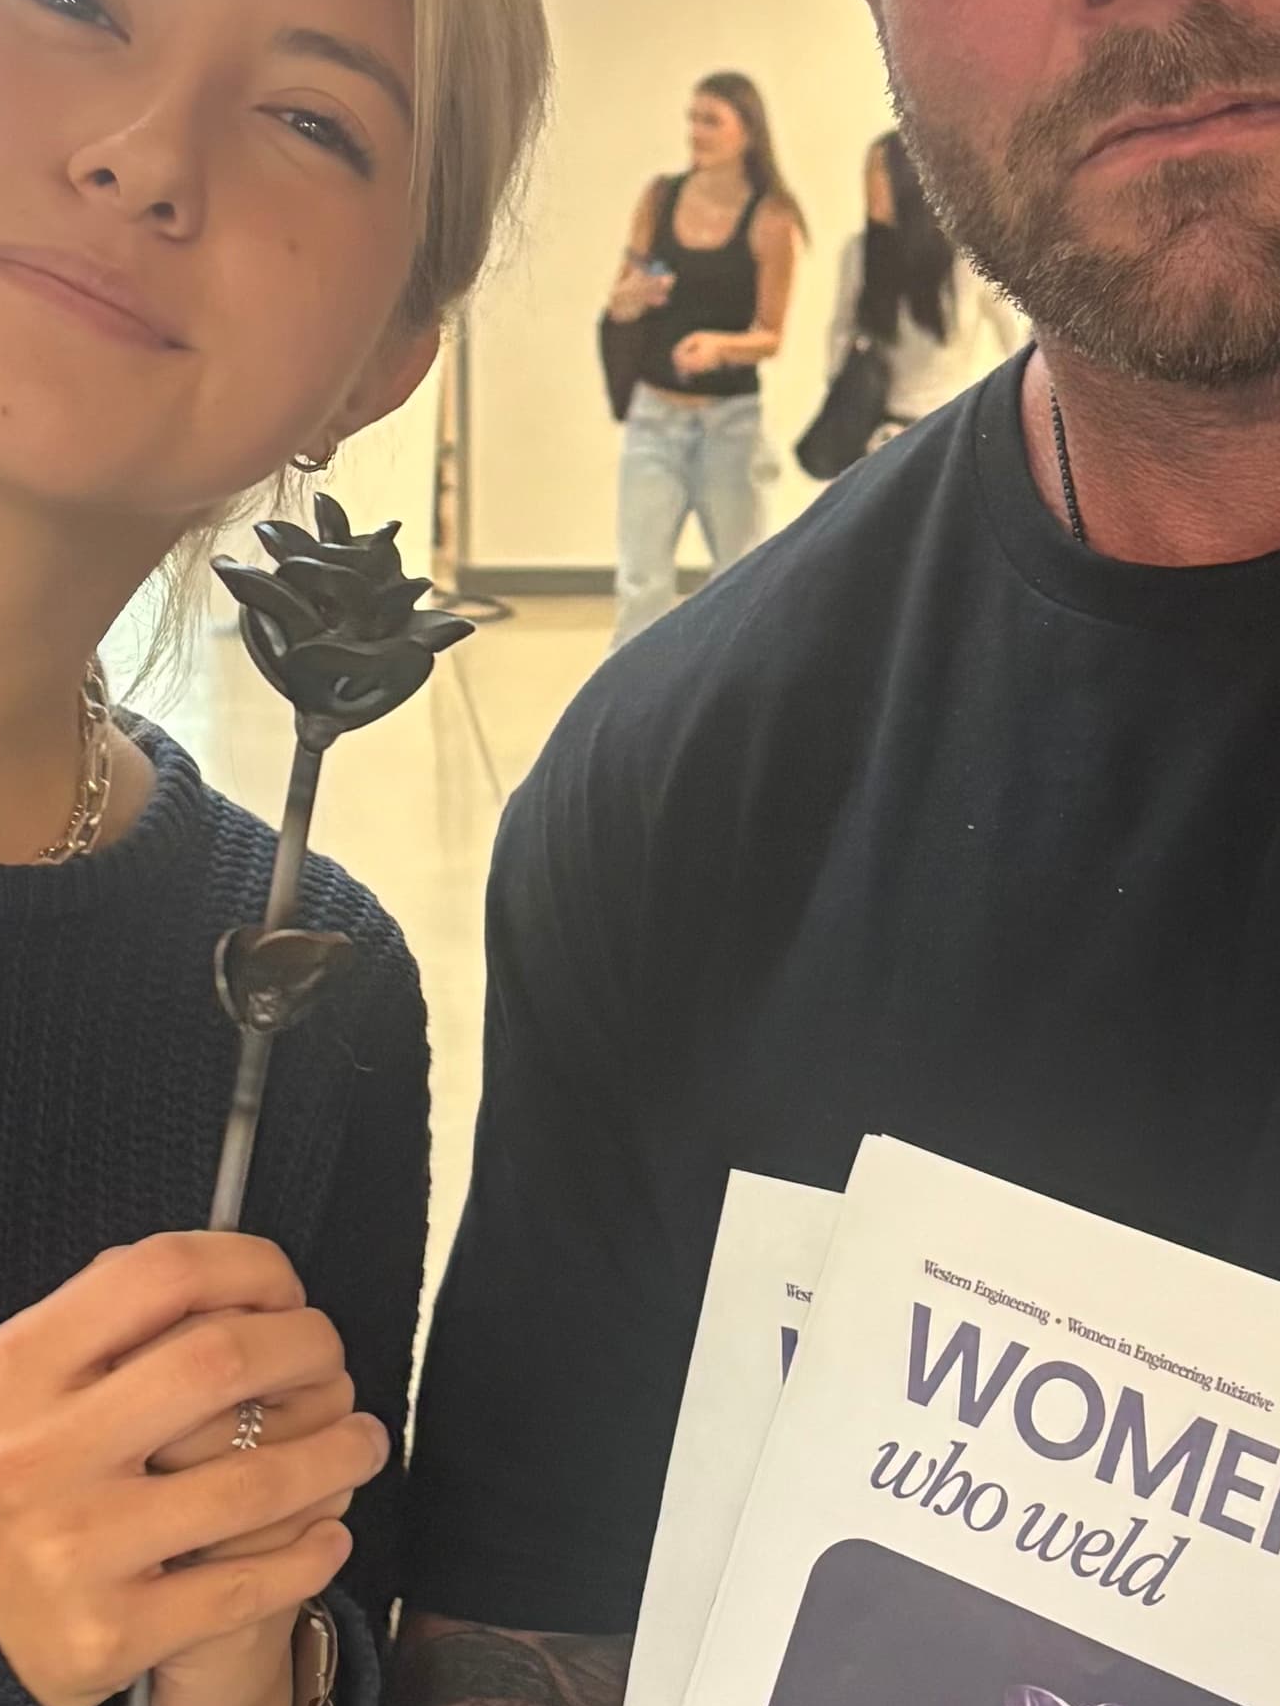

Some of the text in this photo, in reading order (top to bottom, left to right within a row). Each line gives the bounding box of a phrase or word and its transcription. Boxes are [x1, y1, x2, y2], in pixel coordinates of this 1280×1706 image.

[923, 1259, 1274, 1413] Western Engineering Women in Engineering Initiative
[870, 1440, 1191, 1606] who weld
